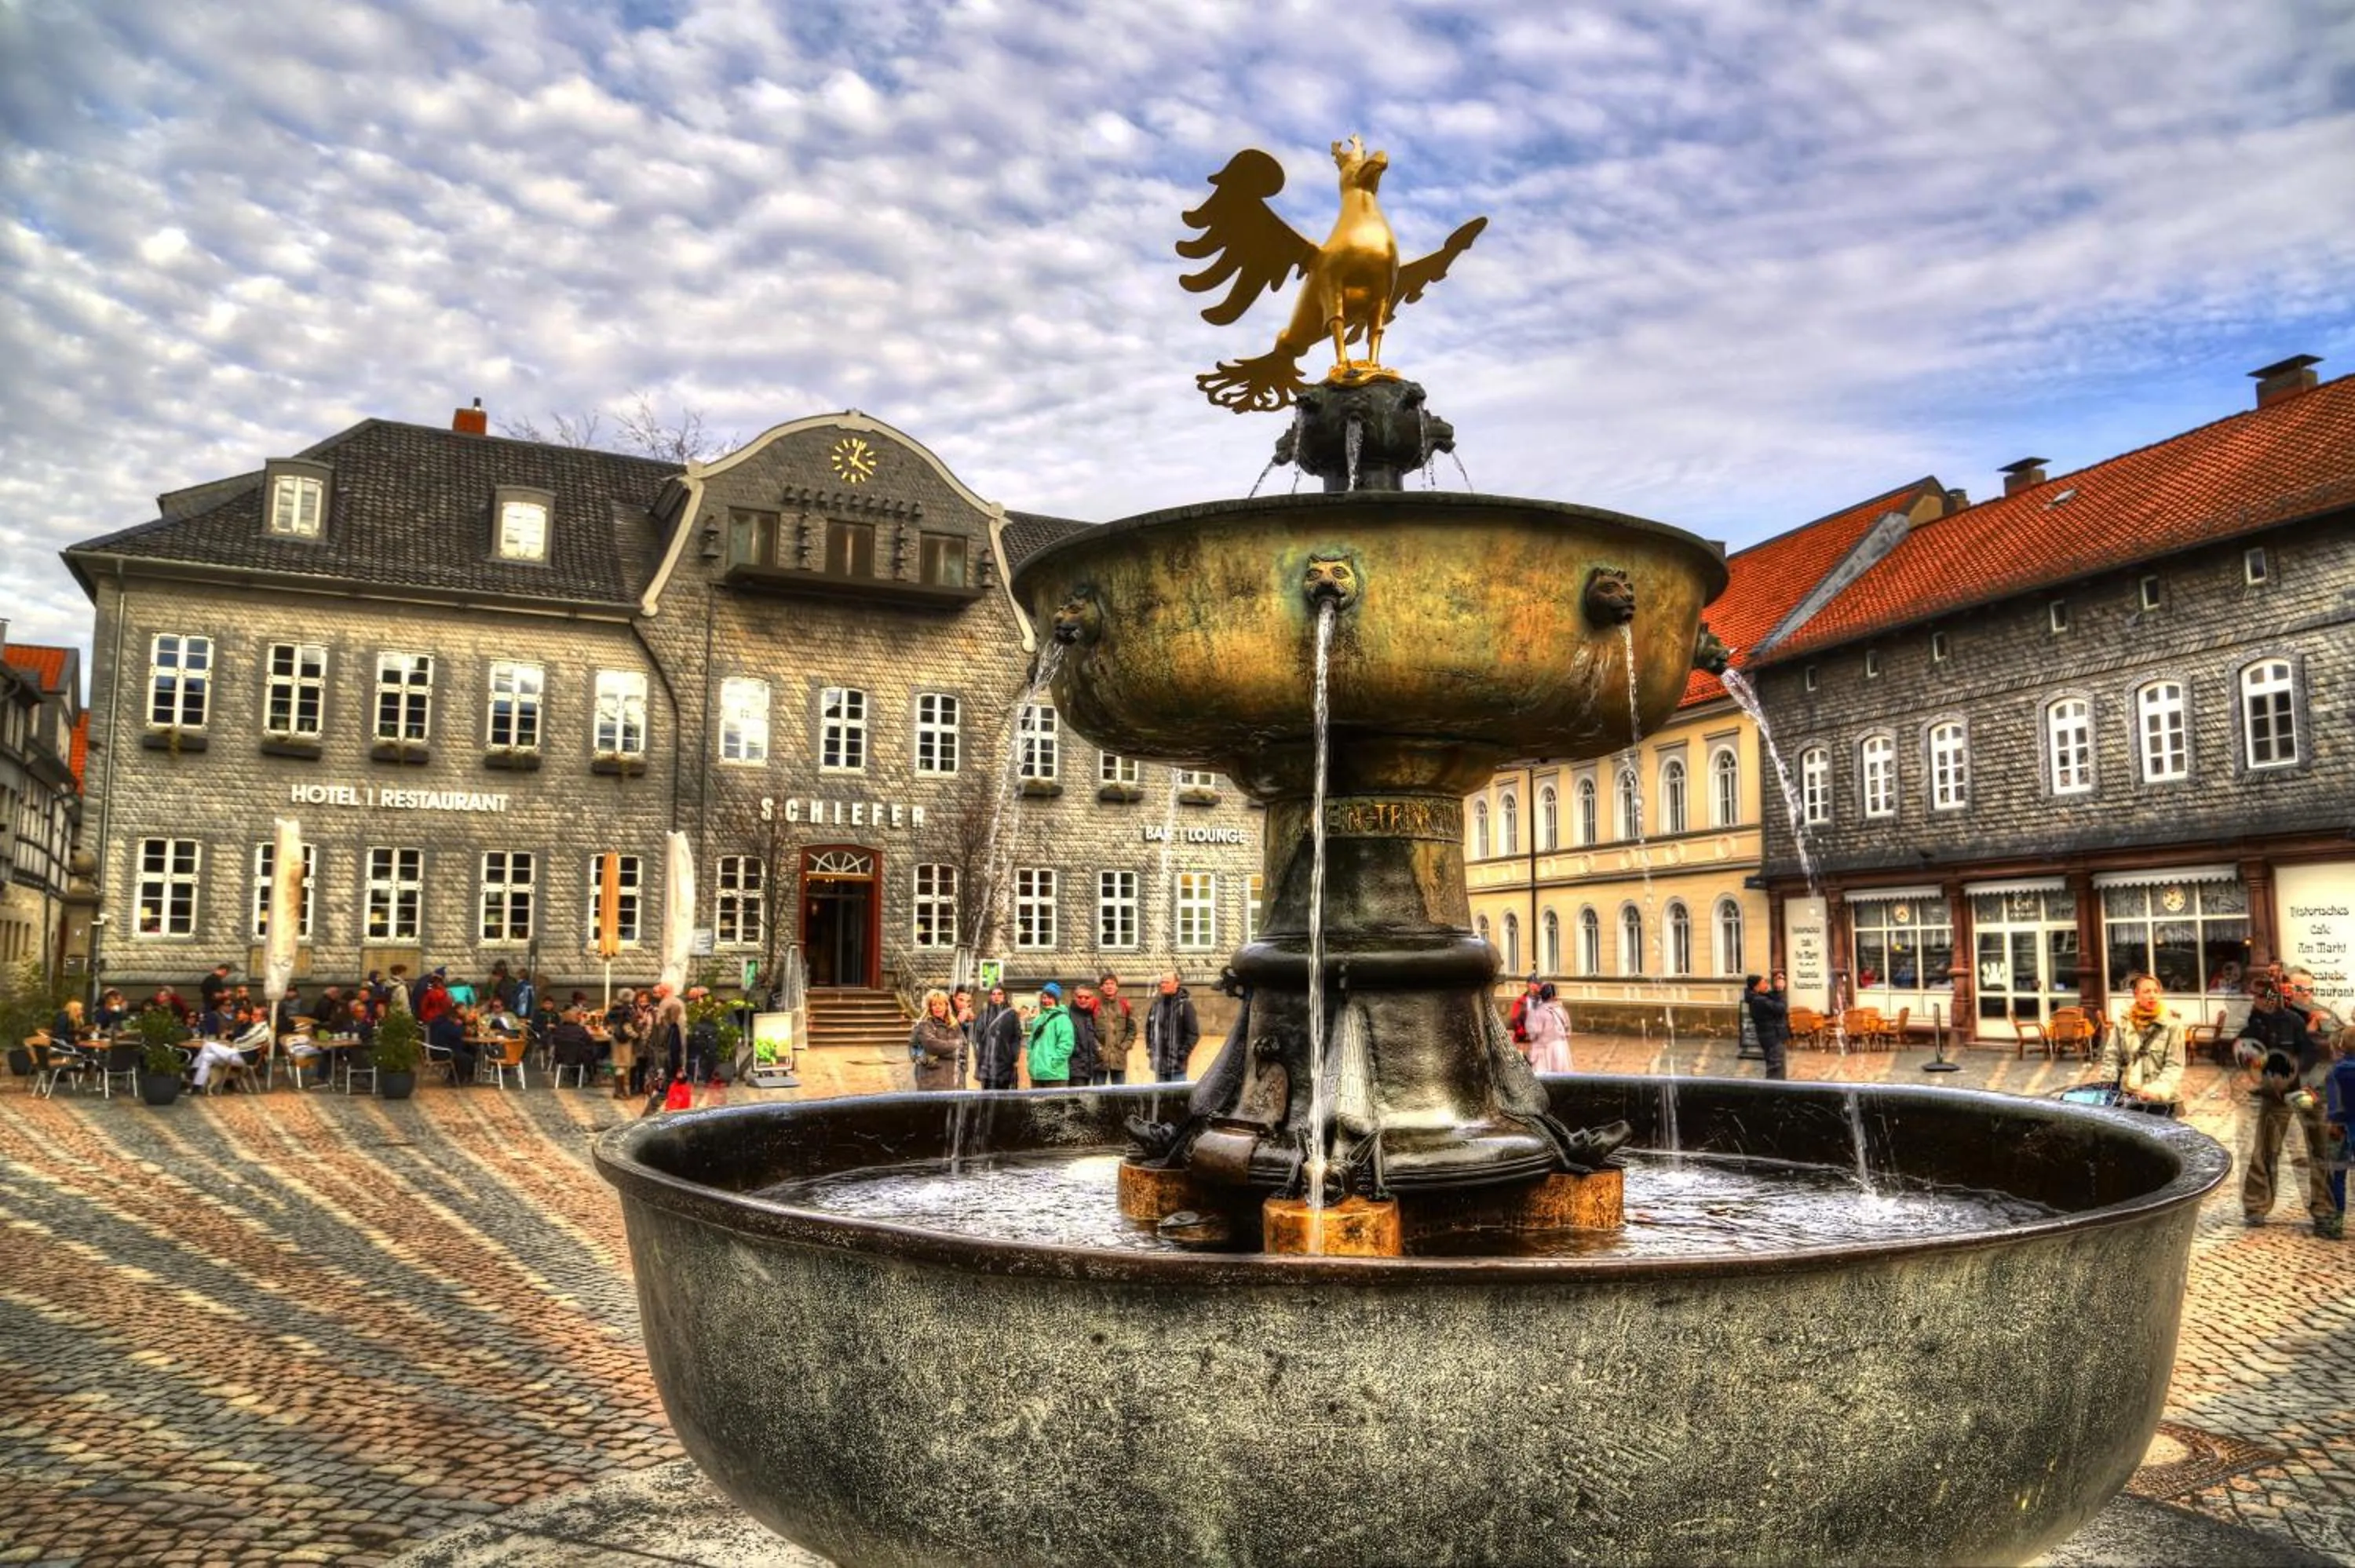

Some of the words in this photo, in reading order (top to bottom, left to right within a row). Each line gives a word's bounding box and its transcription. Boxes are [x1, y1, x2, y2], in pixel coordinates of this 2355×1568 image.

[291, 784, 360, 806] HOTEL
[381, 788, 509, 812] RESTAURANT
[761, 797, 925, 828] SCHIEFER
[1187, 826, 1248, 844] LOUNGE
